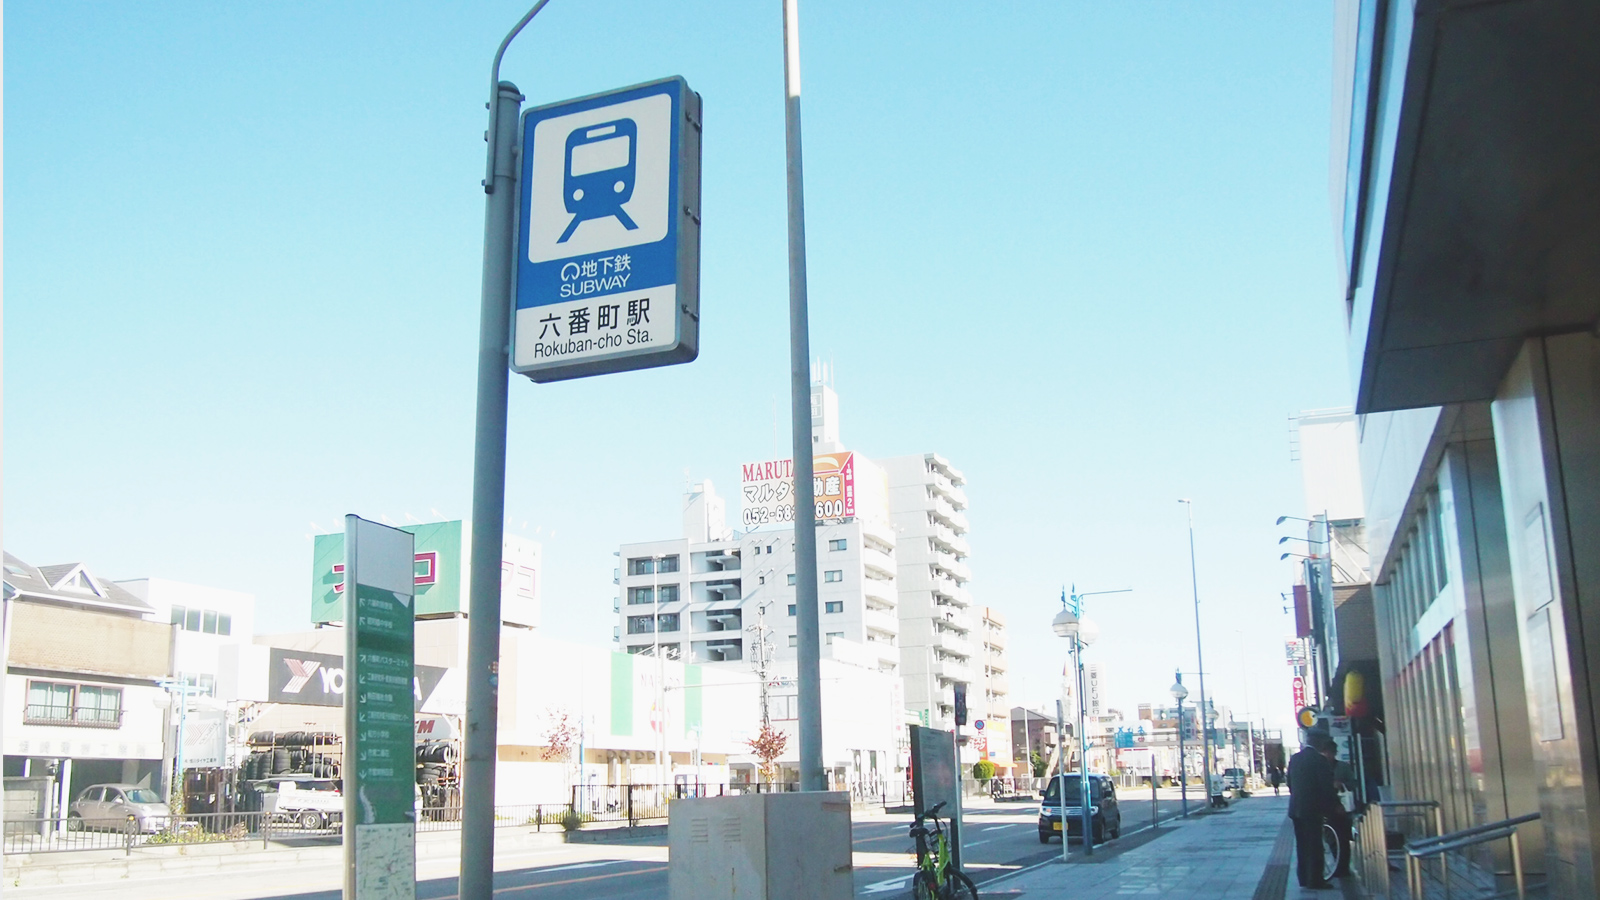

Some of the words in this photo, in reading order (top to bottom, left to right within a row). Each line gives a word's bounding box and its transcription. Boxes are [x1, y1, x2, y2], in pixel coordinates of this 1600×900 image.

[581, 253, 631, 278] 地下鉄
[560, 273, 631, 298] SUBWAY
[539, 298, 650, 340] 六番町駅
[534, 333, 622, 358] Rokuban-cho
[626, 328, 653, 345] Sta.
